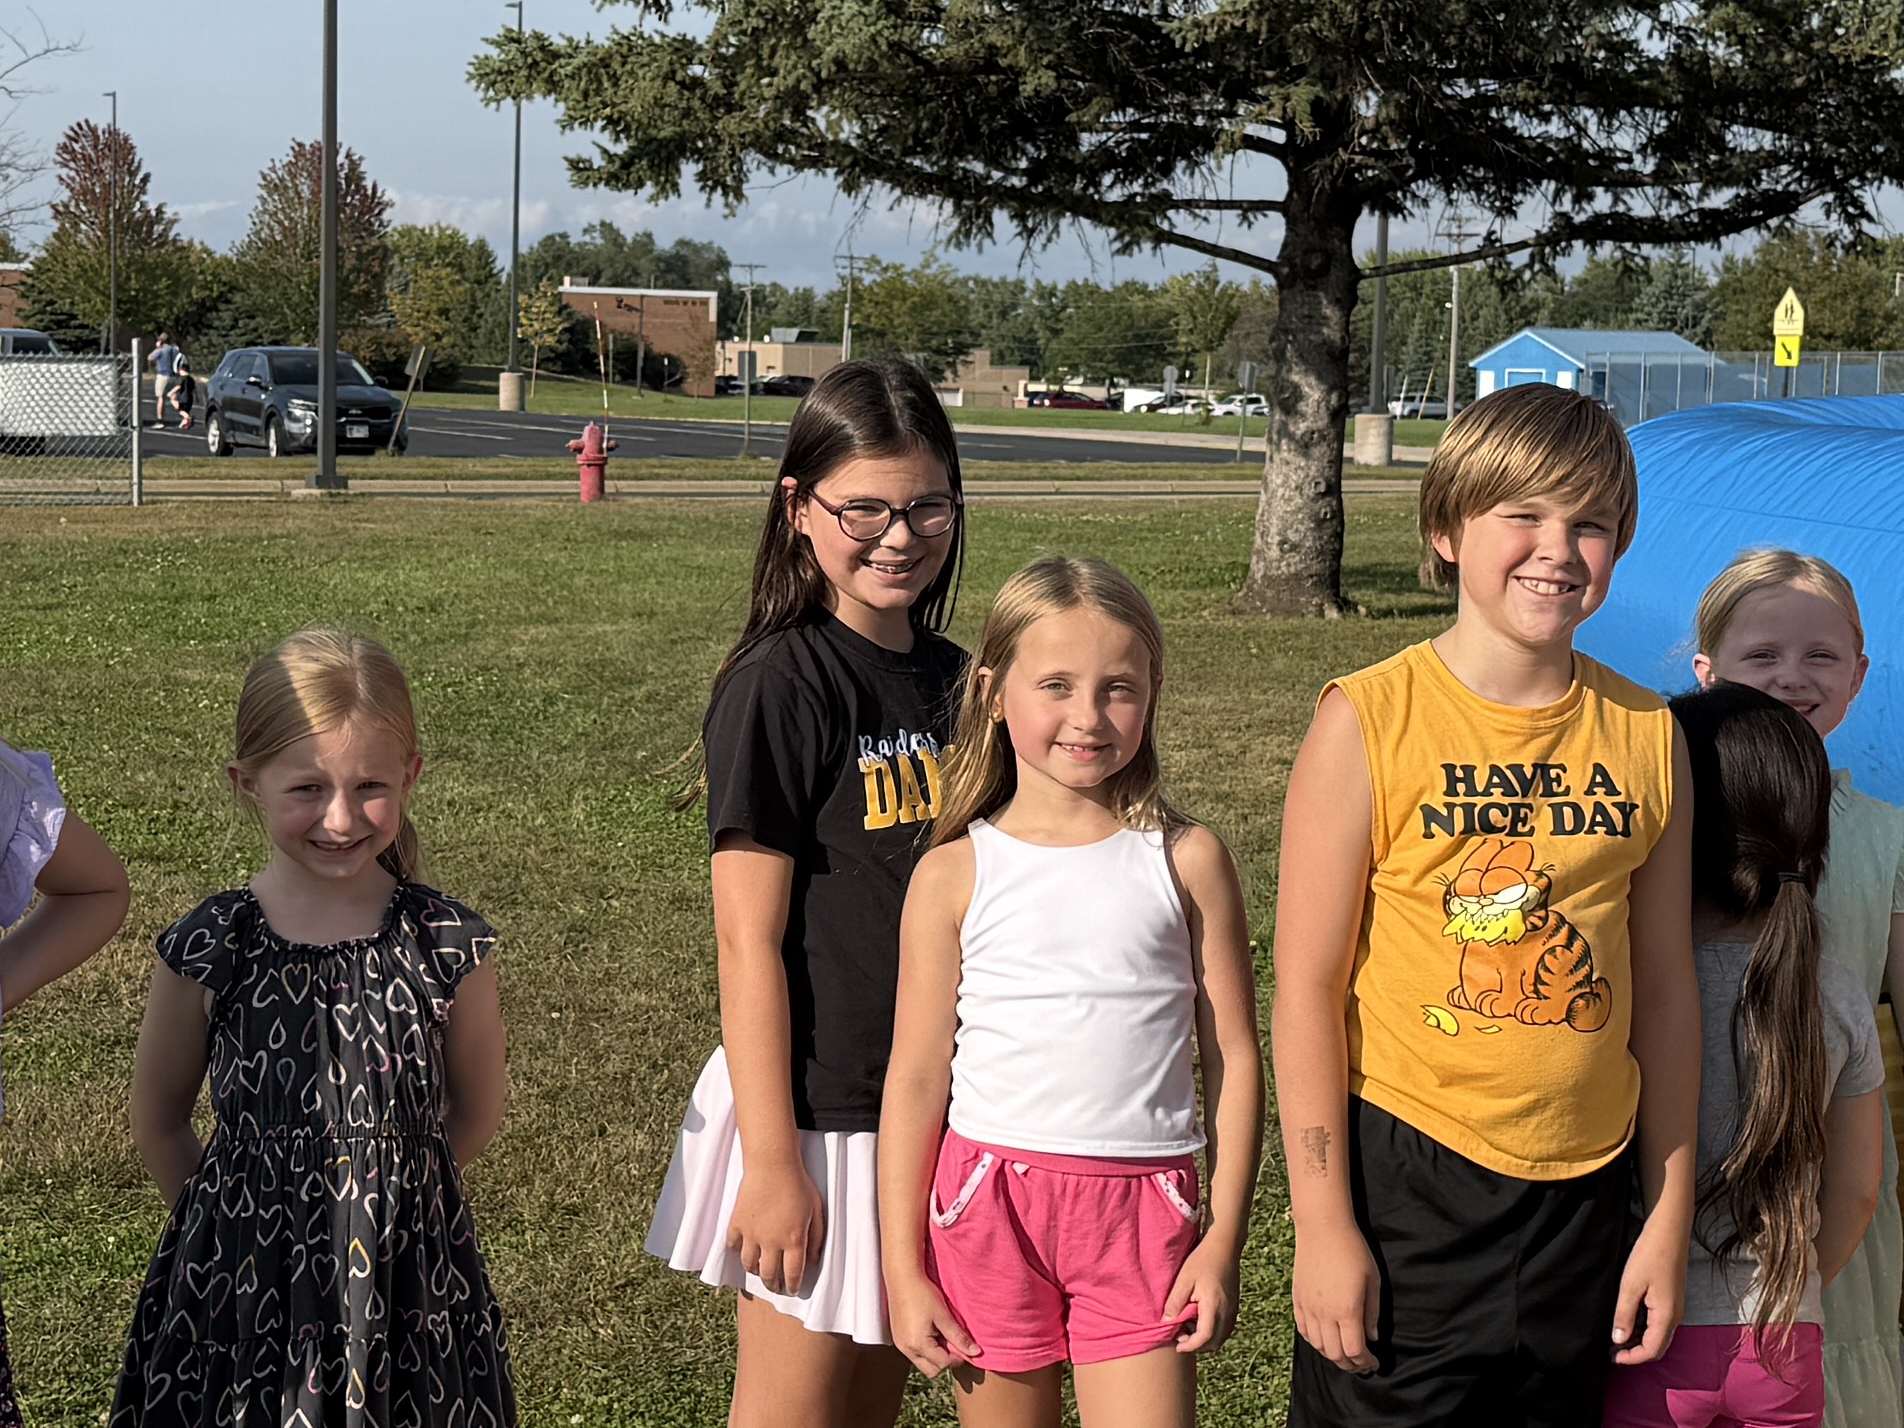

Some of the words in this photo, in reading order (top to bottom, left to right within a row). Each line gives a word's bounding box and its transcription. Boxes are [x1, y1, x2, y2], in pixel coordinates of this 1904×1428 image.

[1440, 763, 1571, 798] HAVE
[1585, 763, 1621, 797] A
[1419, 803, 1536, 839] NICE
[1549, 801, 1639, 838] DAY
